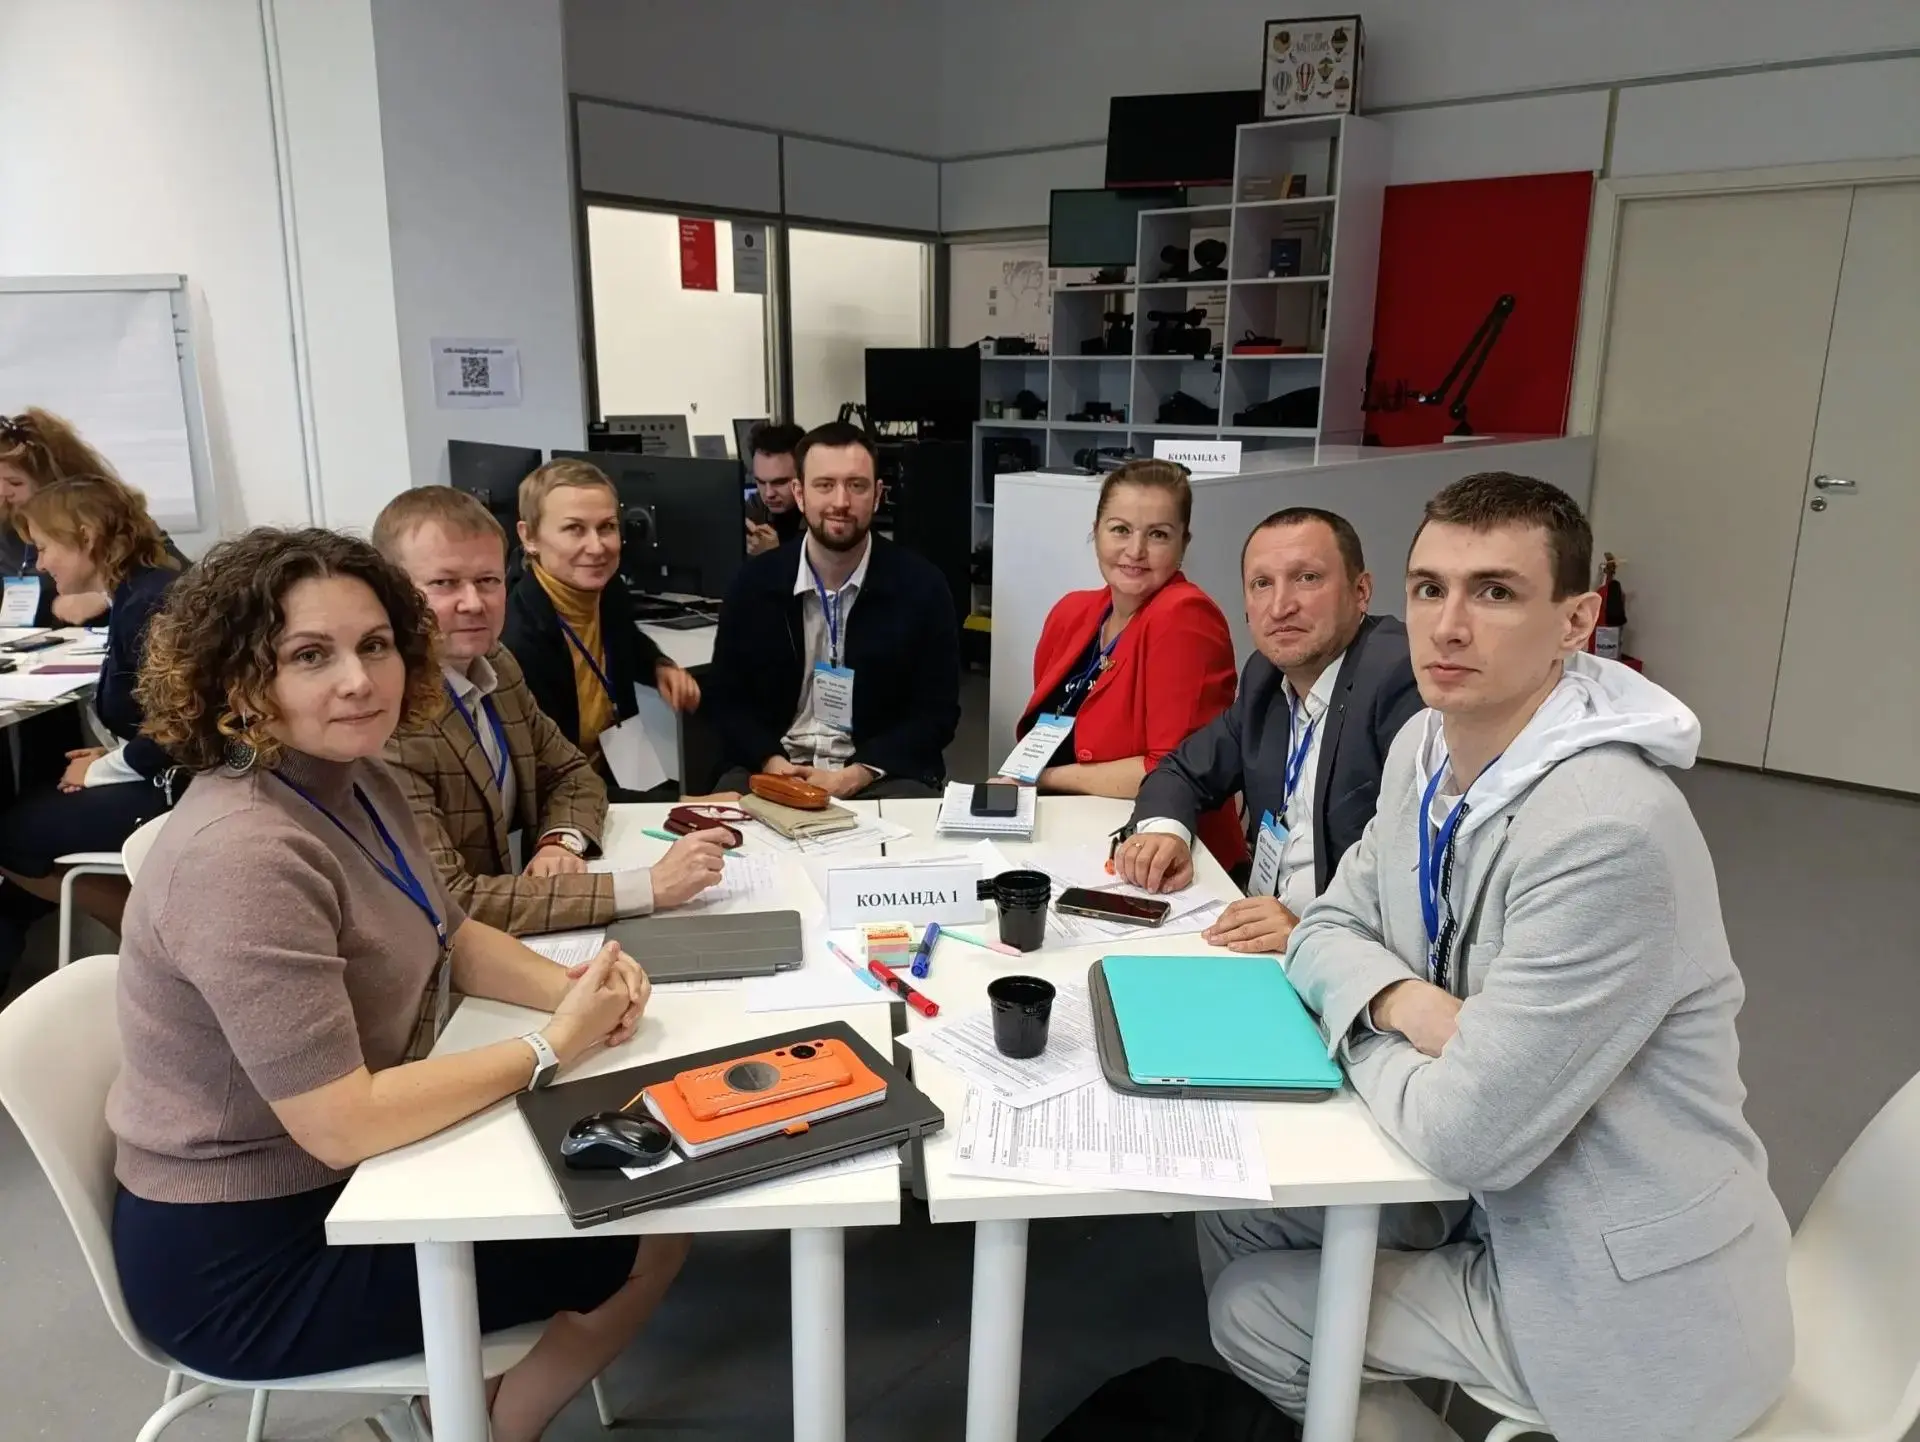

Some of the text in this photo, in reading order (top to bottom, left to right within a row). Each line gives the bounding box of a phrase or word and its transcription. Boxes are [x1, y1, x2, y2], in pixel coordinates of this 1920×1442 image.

[1168, 453, 1226, 462] КОМАНДА 5
[856, 890, 958, 907] КОМАНДА 1
